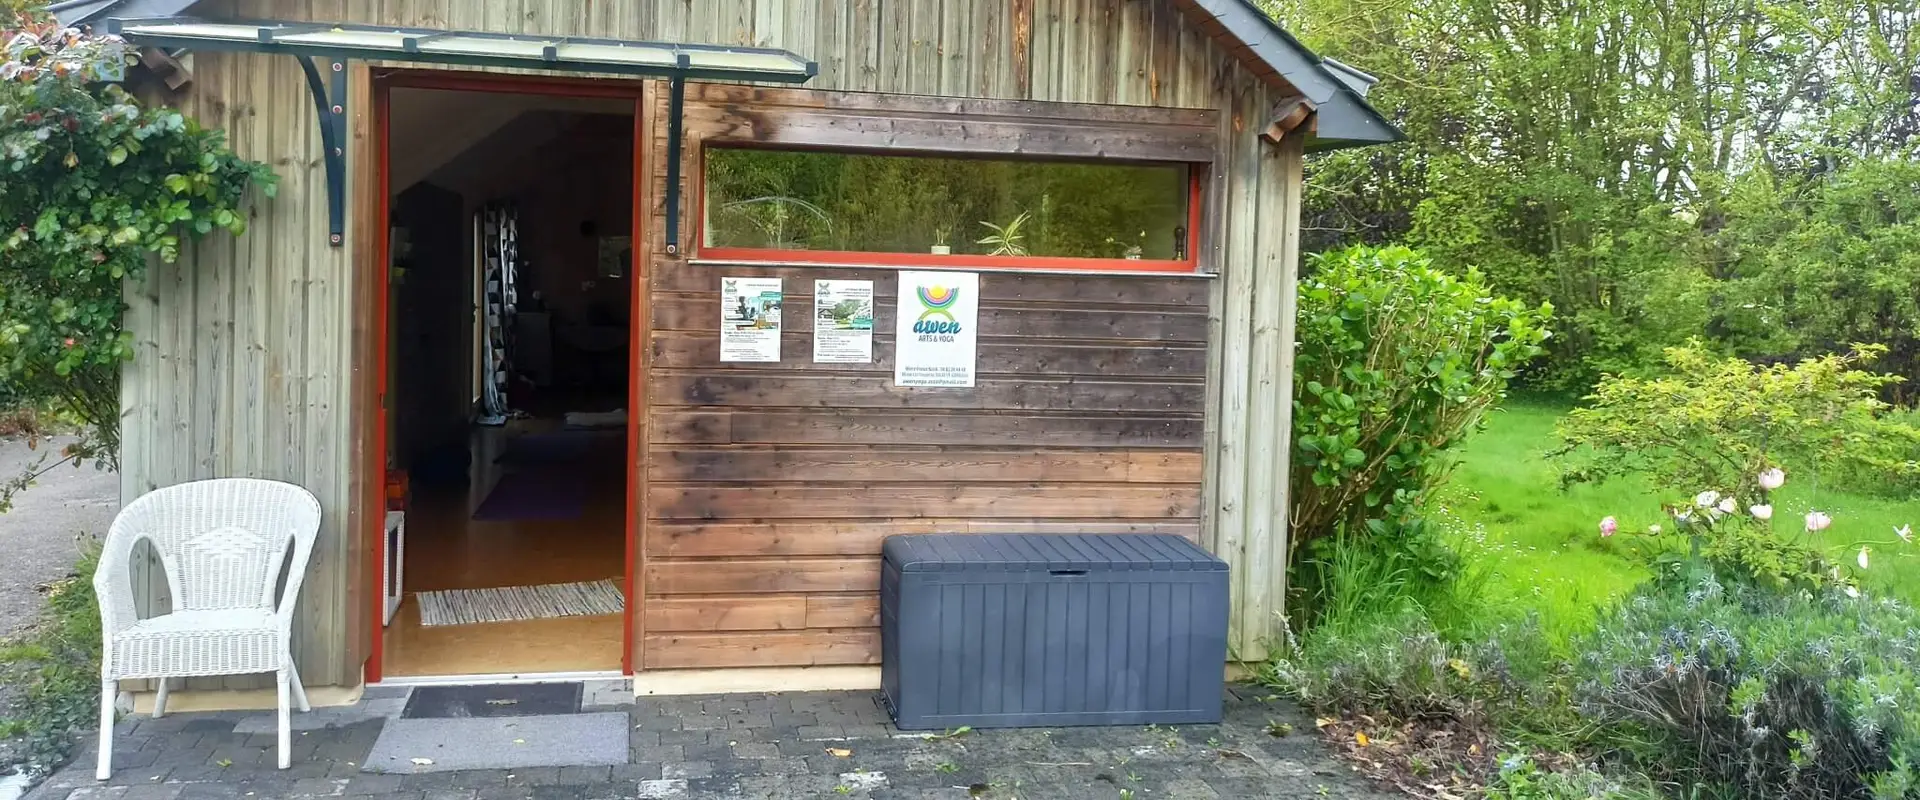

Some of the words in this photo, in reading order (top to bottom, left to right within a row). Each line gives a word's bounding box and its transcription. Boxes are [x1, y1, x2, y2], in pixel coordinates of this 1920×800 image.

[913, 320, 962, 334] awen
[918, 335, 933, 343] ARTS
[933, 335, 938, 343] &
[939, 335, 955, 343] YOGA
